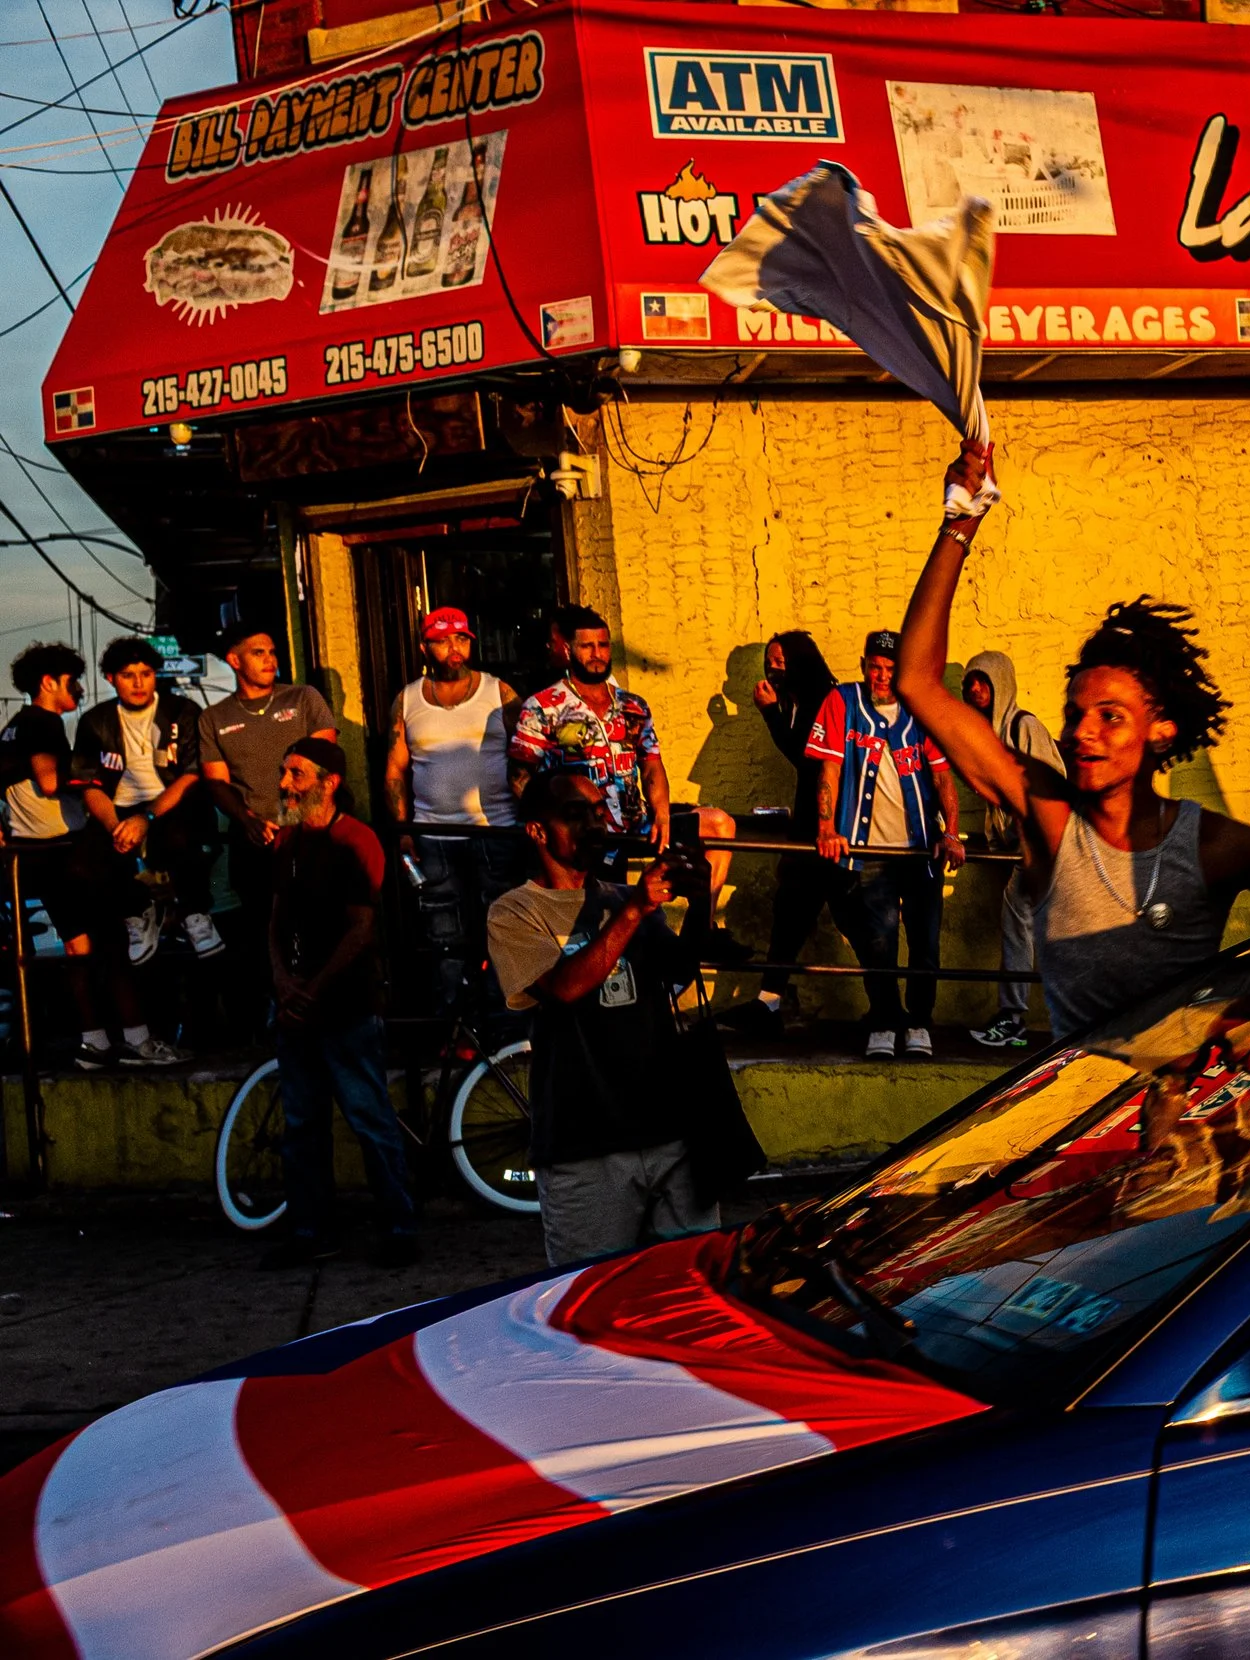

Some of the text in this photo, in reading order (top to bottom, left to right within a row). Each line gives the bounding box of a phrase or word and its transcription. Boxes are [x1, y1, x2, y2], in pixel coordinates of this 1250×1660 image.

[169, 34, 543, 180] BILL PAYMENT CENTER
[669, 60, 822, 113] ATM
[670, 116, 827, 135] AVAILABLE
[639, 191, 740, 245] HOT
[325, 322, 485, 386] 215-475-6500
[142, 357, 287, 417] 215-427-0045
